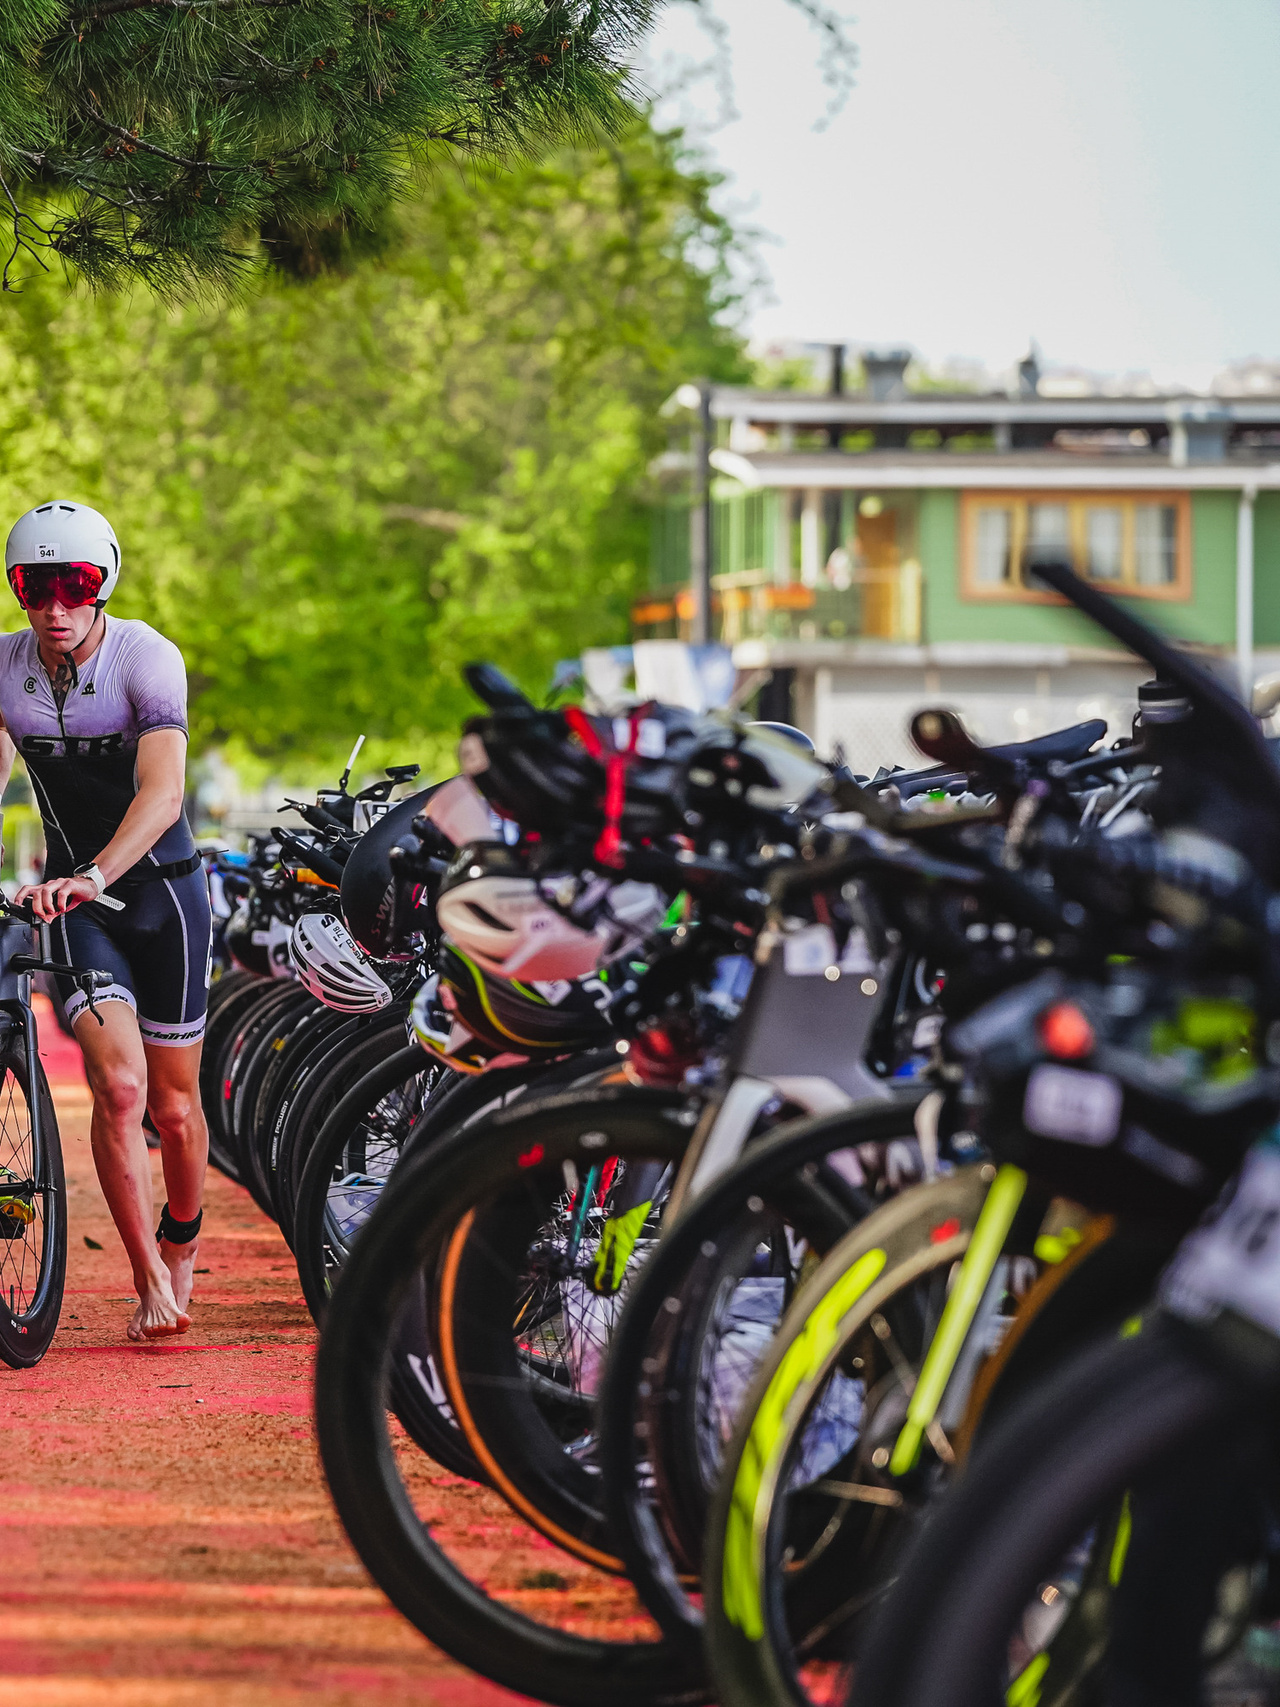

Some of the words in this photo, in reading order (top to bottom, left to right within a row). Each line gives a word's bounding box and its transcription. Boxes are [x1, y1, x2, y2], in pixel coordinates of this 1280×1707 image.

[40, 549, 55, 557] 941
[22, 732, 123, 757] STR
[332, 925, 345, 938] 718
[274, 1100, 289, 1134] POWER
